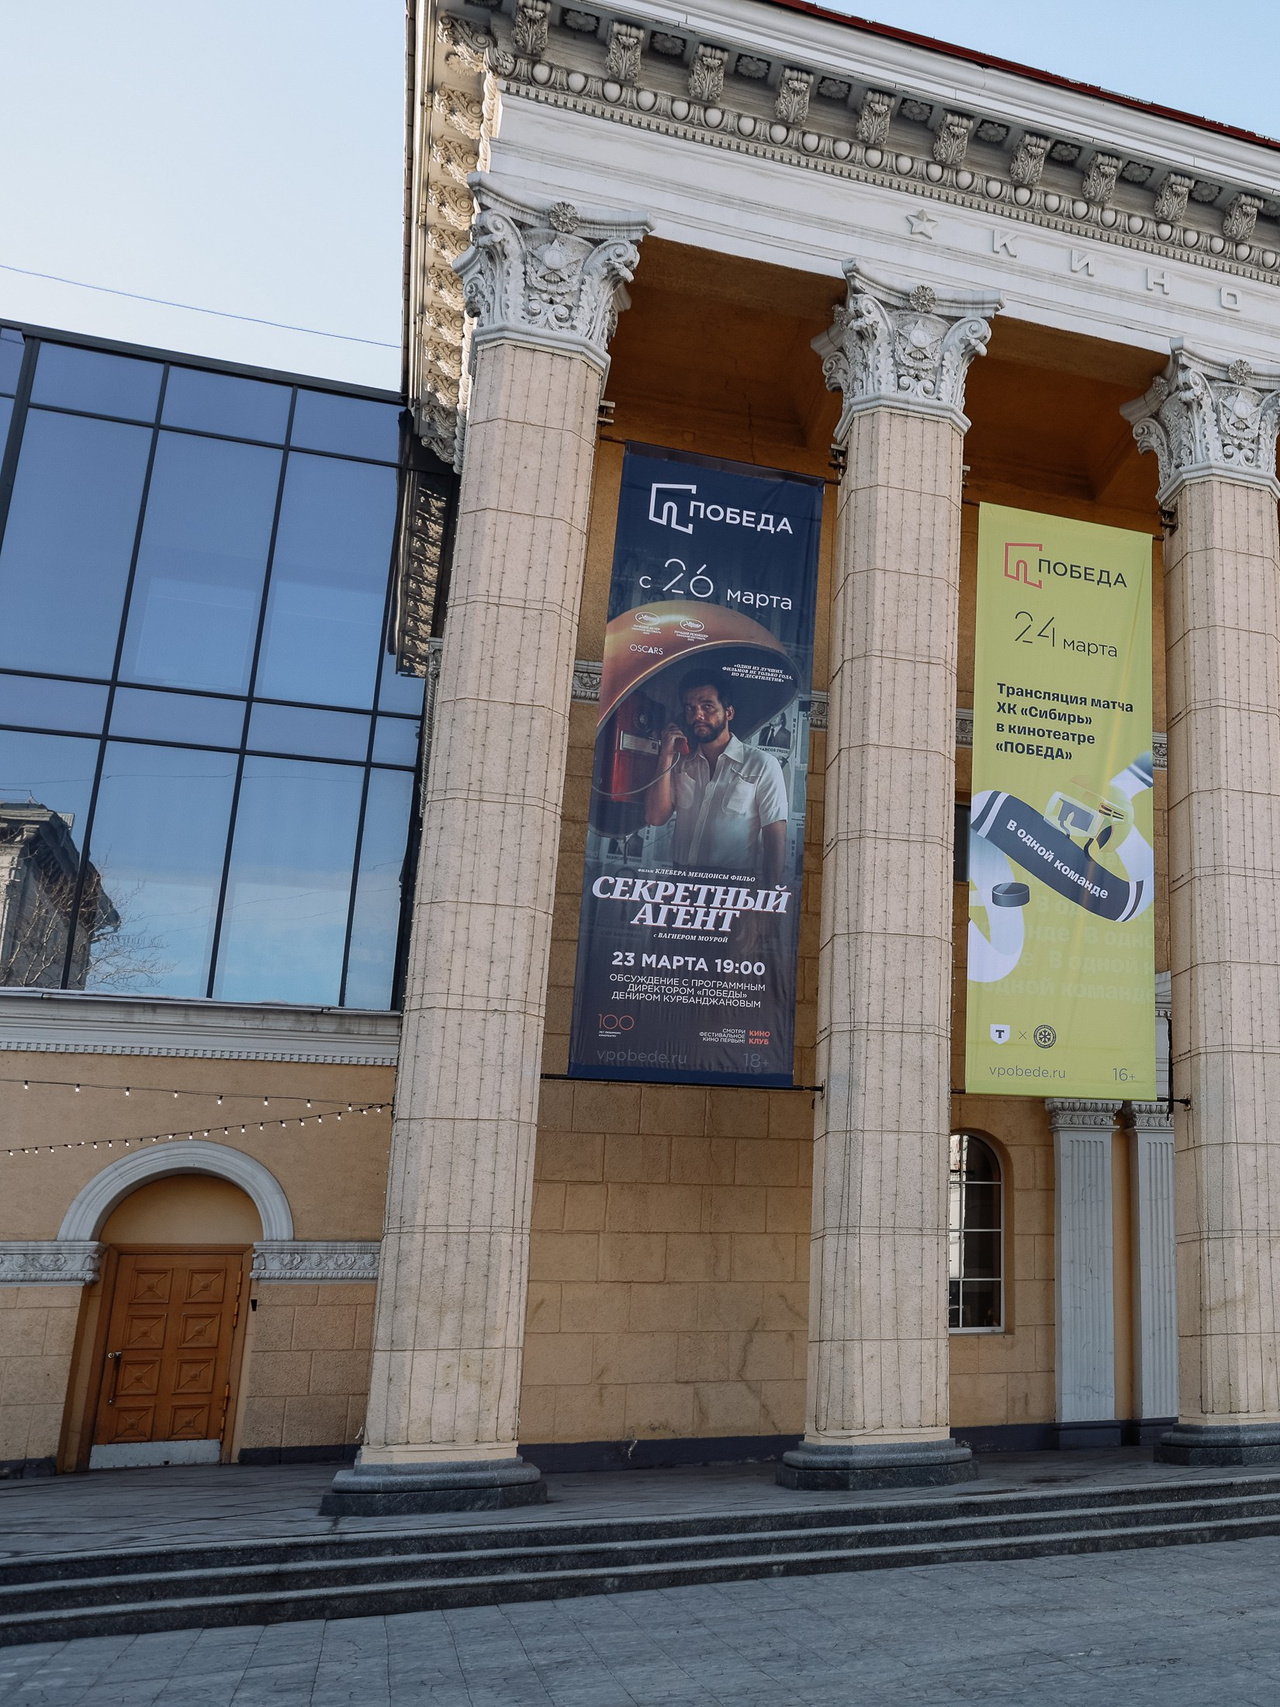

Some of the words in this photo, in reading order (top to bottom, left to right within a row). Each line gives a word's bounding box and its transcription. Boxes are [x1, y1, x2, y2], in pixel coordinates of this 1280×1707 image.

[689, 501, 793, 534] ПОБЕДА
[1038, 558, 1127, 588] ПОБЕДА
[662, 558, 714, 598] 26
[727, 589, 792, 610] марта
[1015, 610, 1055, 647] 24
[1063, 638, 1118, 658] марта
[630, 644, 664, 655] OSCARS
[997, 682, 1087, 706] Трансляция
[1090, 698, 1134, 713] матча
[996, 702, 1017, 715] ХК
[1020, 706, 1092, 725] «Сибирь»
[996, 723, 1005, 733] в
[1008, 724, 1095, 745] кинотеатре
[995, 741, 1072, 760] «ПОБЕДА»
[1006, 819, 1017, 831] В
[1017, 828, 1055, 863] одной
[1053, 859, 1109, 899] команде
[655, 868, 687, 877] КЛЕБЕРА
[688, 871, 729, 880] МЕНДОНСЫ
[730, 874, 756, 882] ФИЛЬО
[592, 875, 791, 913] СЕКРЕТНЫЙ
[630, 903, 740, 932] АГЕНТ
[658, 932, 696, 941] ВАГНЕРОМ
[698, 935, 729, 943] МОУРОЙ
[611, 951, 635, 966] 23
[641, 953, 708, 972] МАРТА
[715, 958, 766, 976] 19:00
[609, 973, 679, 986] ОБСУЖДЕНИЕ
[682, 978, 689, 986] С
[691, 979, 766, 991] ПРОГРАММНЫМ
[627, 983, 695, 995] ДИРЕКТОРОМ
[697, 988, 747, 999] «ПОБЕДЫ»
[611, 991, 661, 1002] ДЕНИРОМ
[663, 995, 761, 1008] КУРБАНДЖАНОВЫМ
[598, 1013, 635, 1031] 100
[596, 1049, 687, 1064] vpobede.ru
[989, 1065, 1066, 1078] vpobede.ru
[1112, 1068, 1135, 1082] 16+
